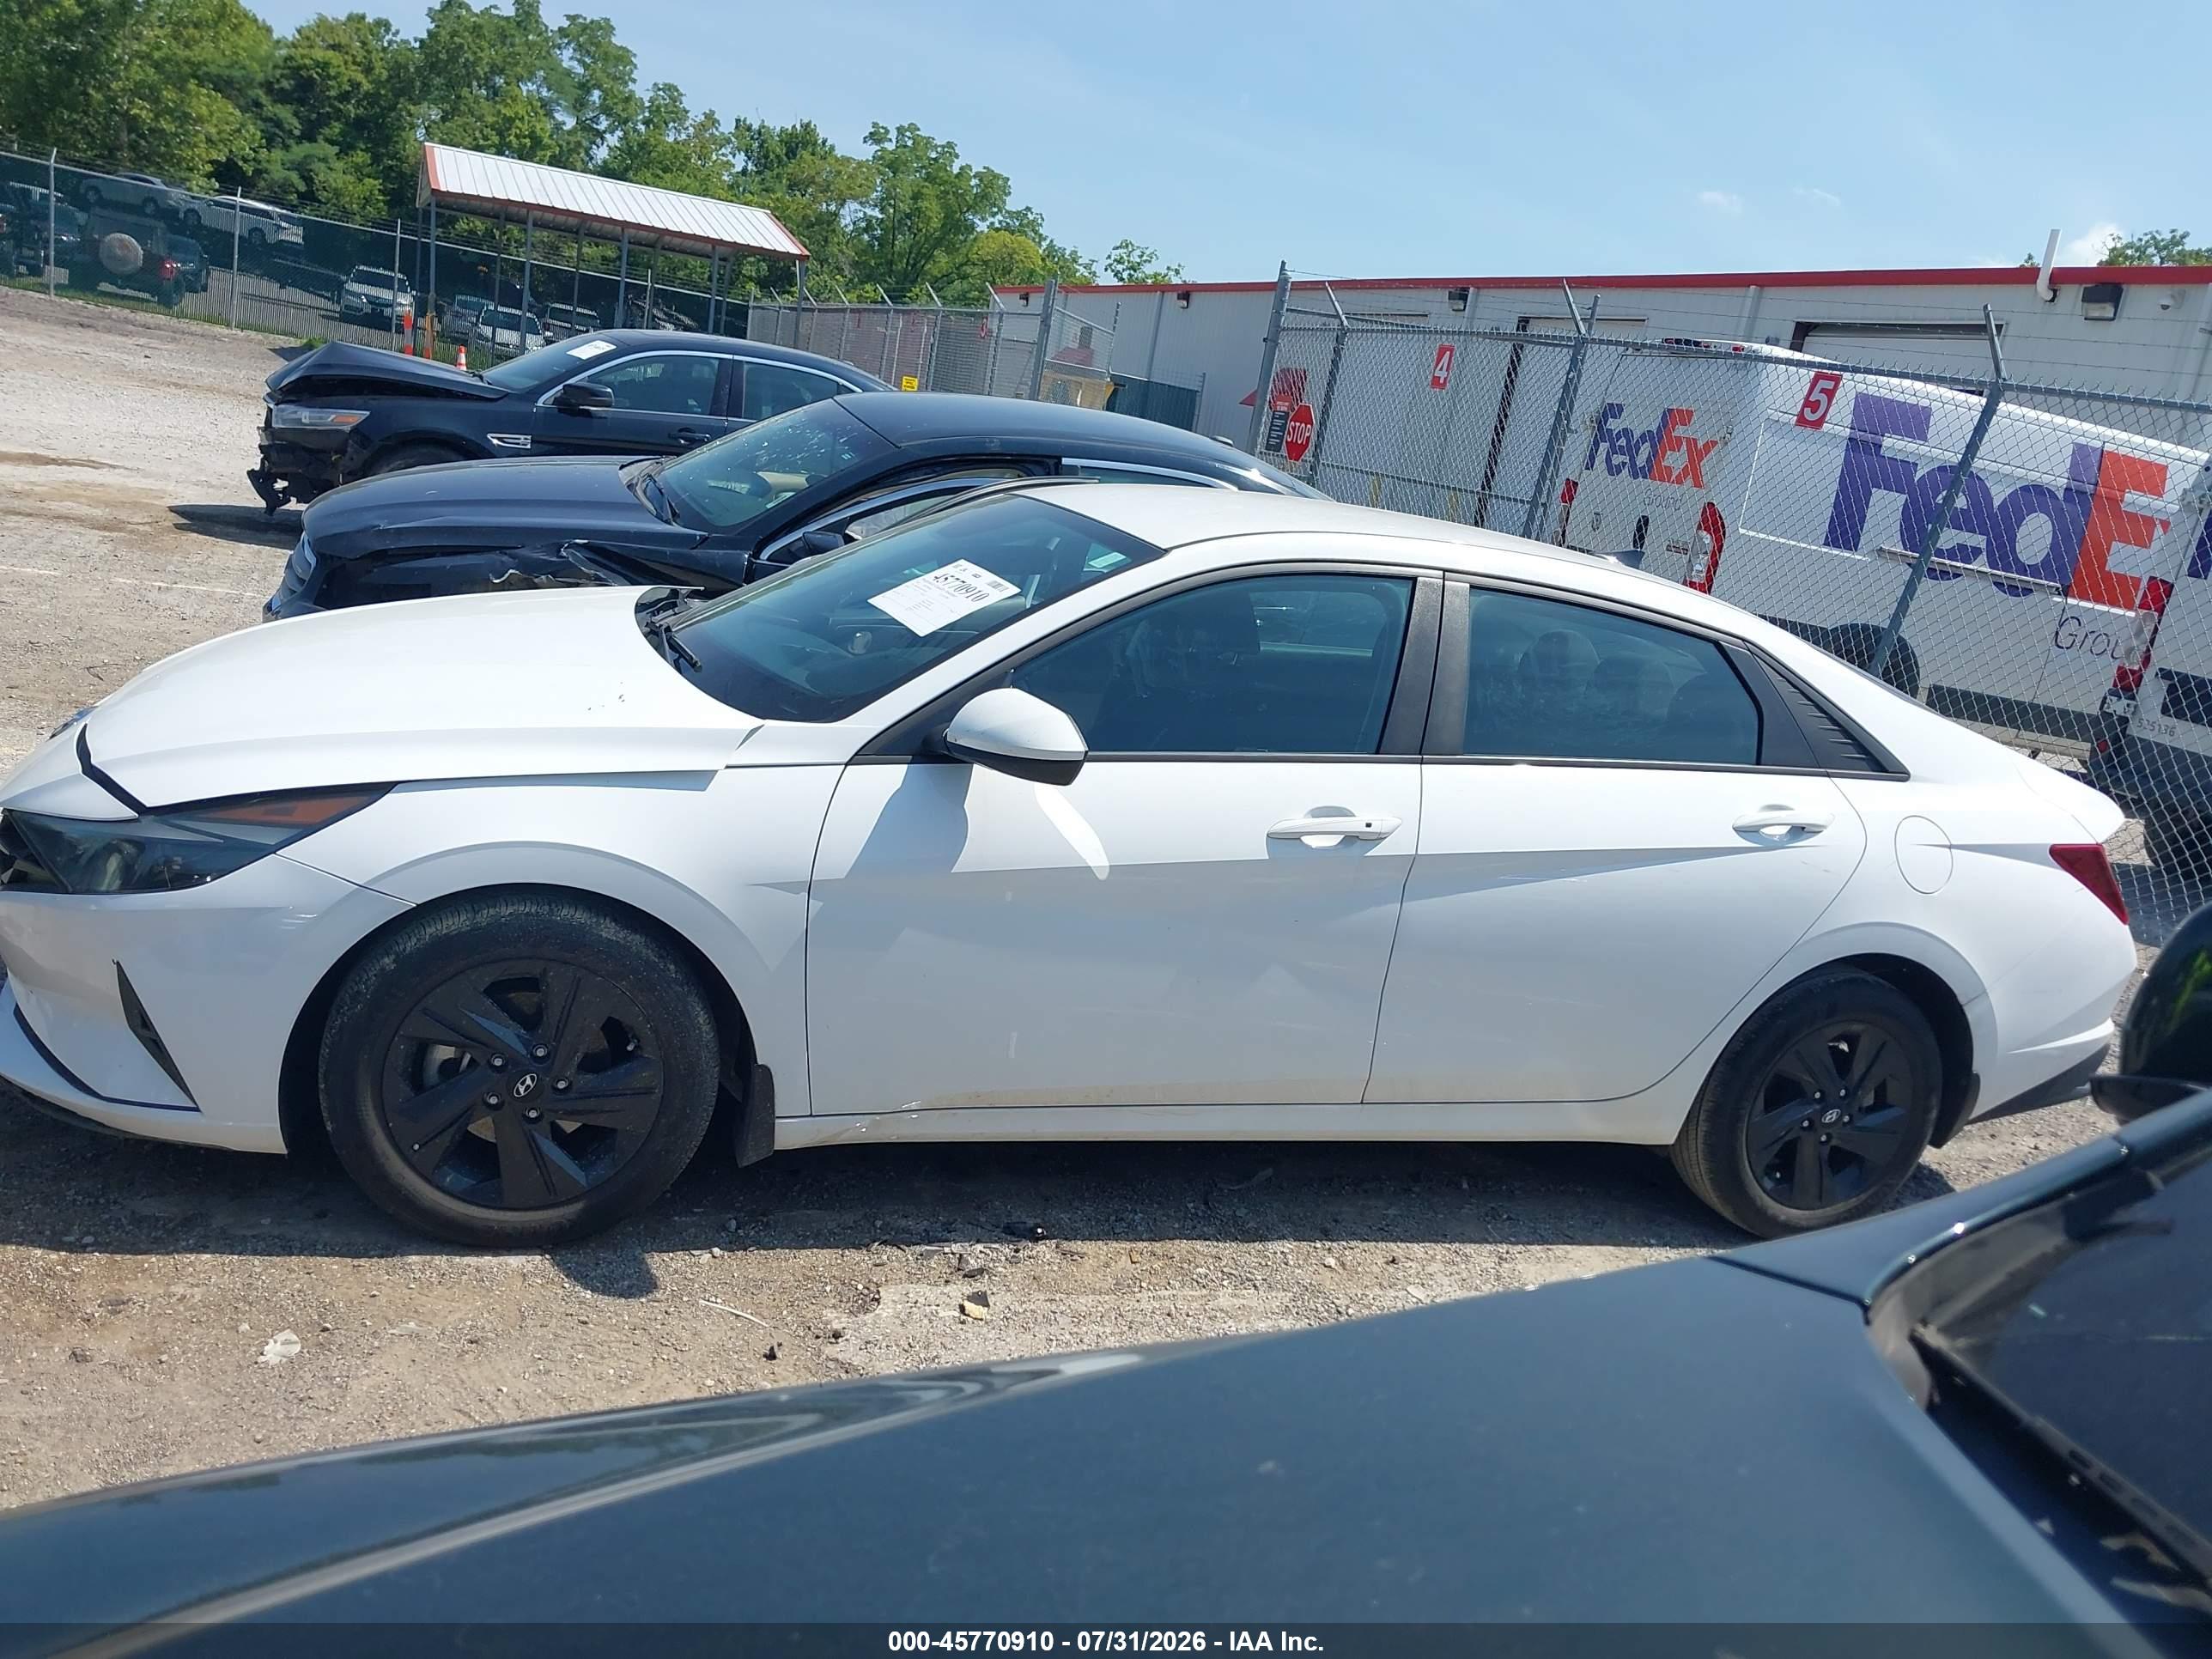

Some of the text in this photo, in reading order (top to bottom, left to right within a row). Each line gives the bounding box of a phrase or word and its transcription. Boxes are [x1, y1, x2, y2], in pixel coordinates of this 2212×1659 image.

[1434, 351, 1450, 384] 4
[1803, 379, 1836, 421] 5
[1287, 421, 1312, 446] STOP
[1584, 403, 1718, 489] FedEx
[1643, 488, 1684, 512] Ground
[1824, 392, 2171, 610] FedE
[933, 573, 990, 603] 45770910
